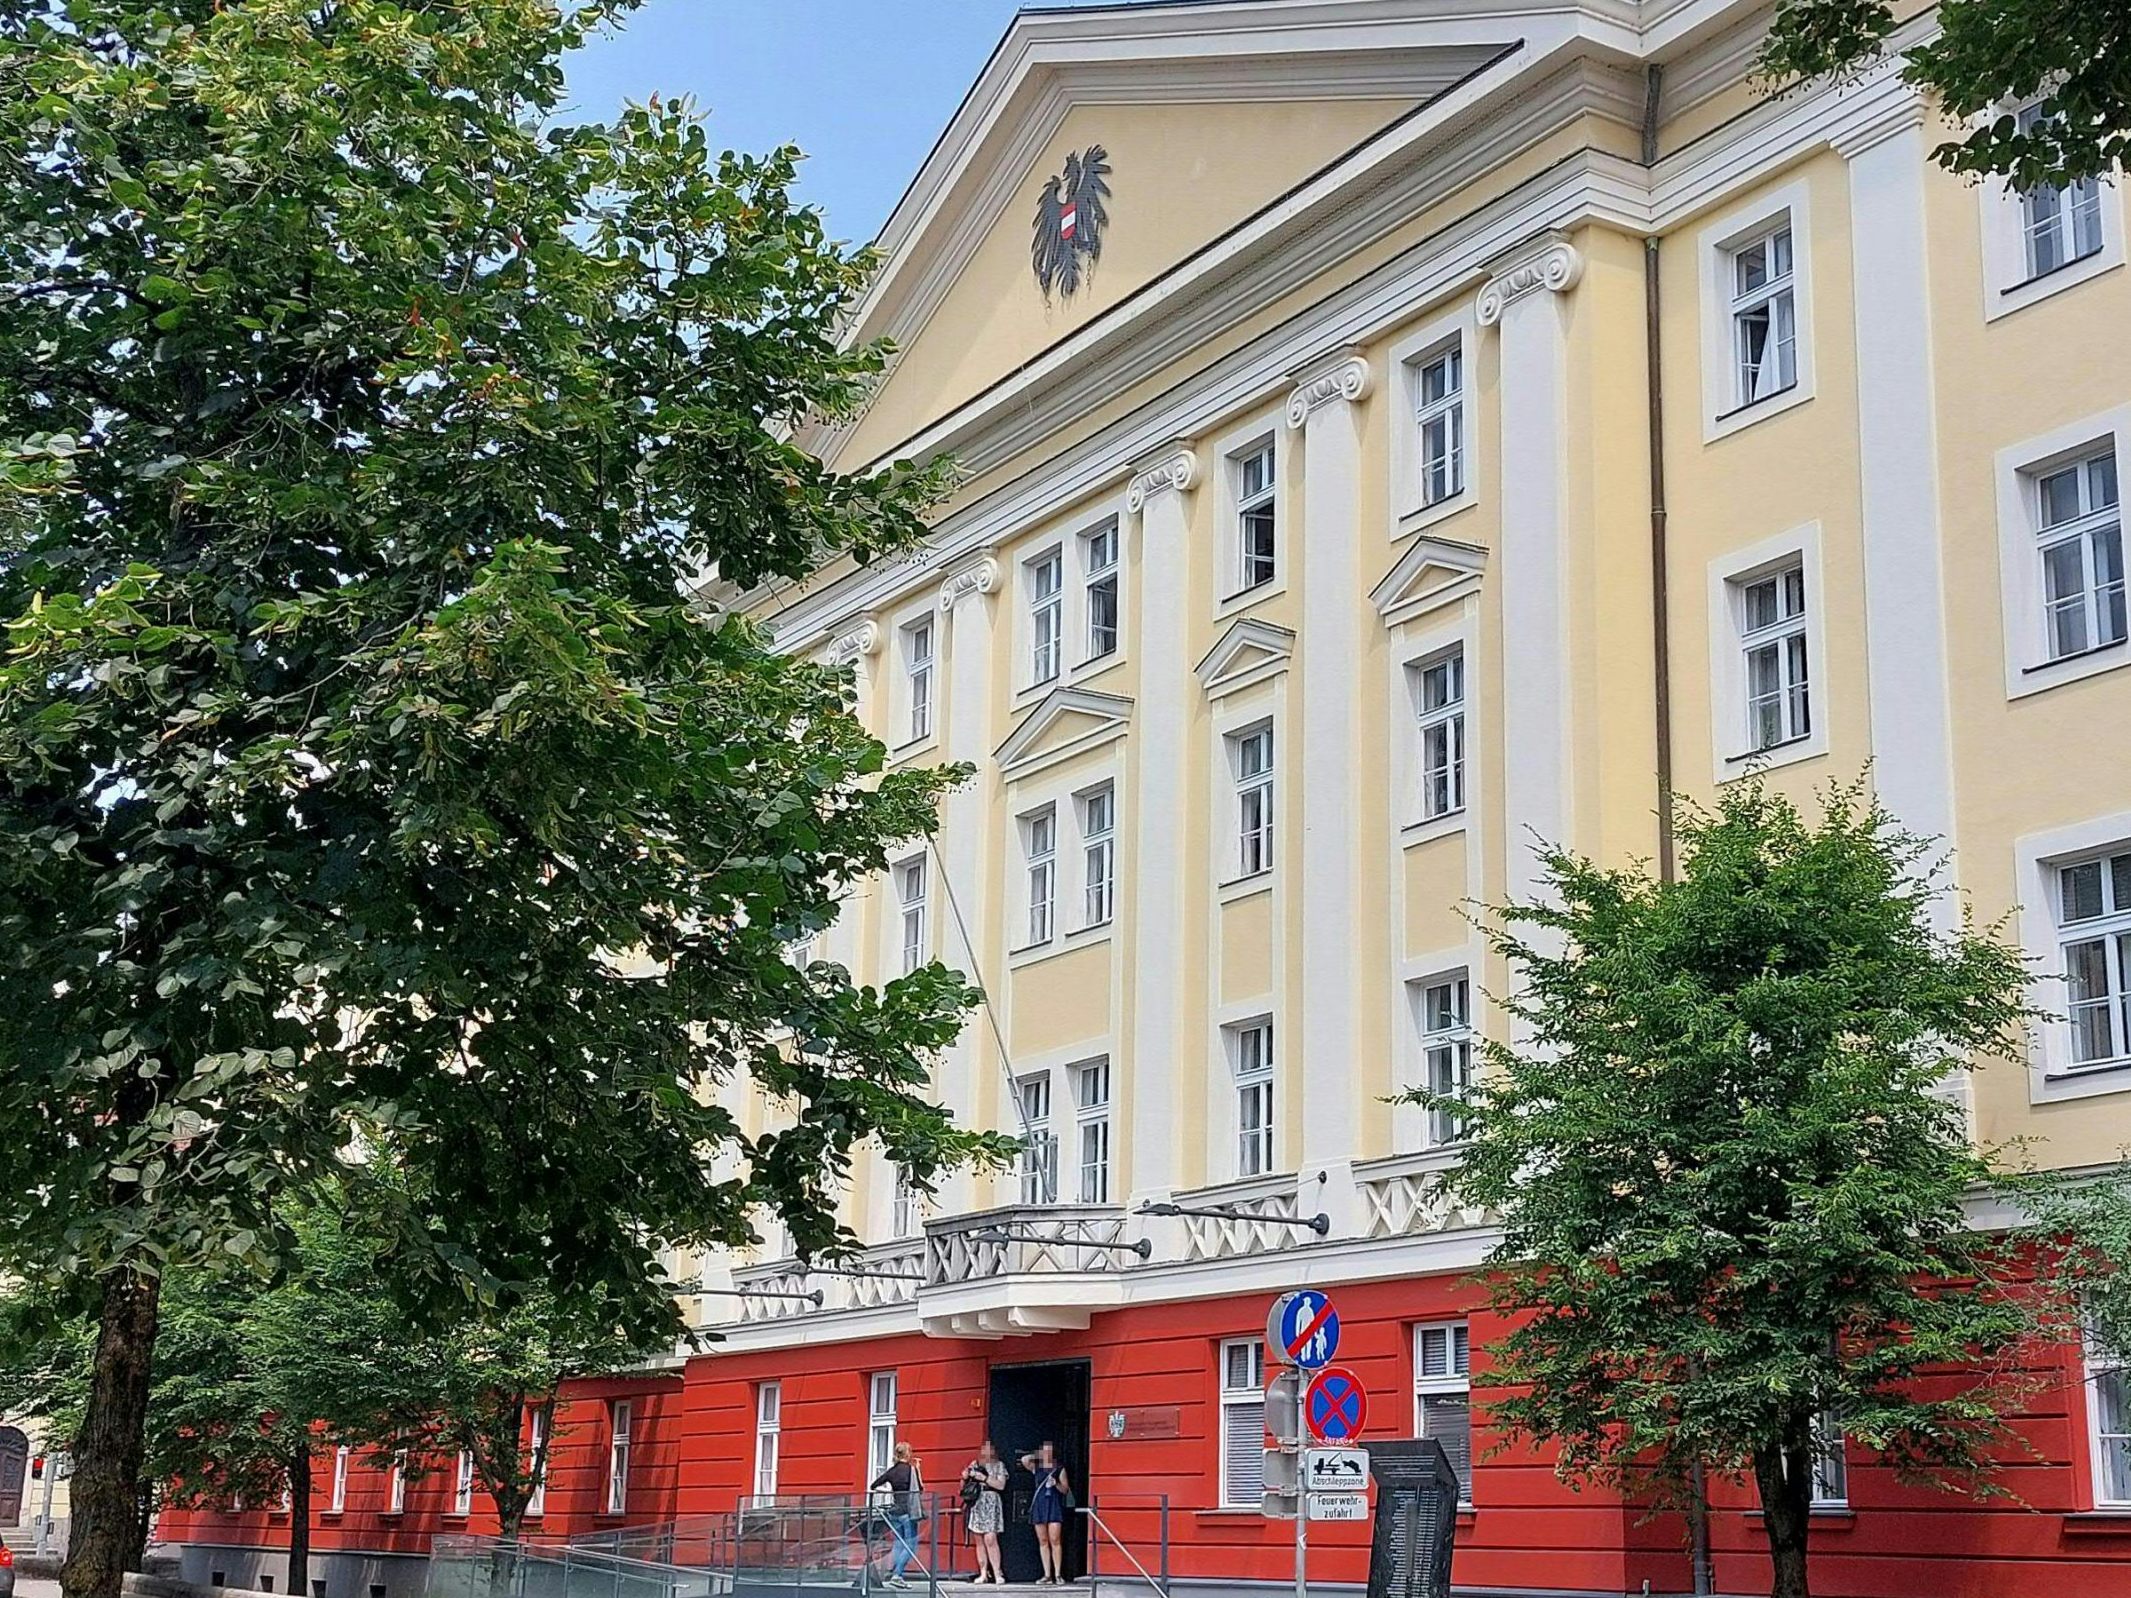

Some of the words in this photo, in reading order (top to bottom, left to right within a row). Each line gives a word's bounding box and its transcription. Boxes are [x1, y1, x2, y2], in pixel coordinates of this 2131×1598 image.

[1312, 1476, 1364, 1487] Abschleppzone
[1317, 1494, 1362, 1505] Feuerwehr-
[1324, 1508, 1353, 1518] zufahrt
